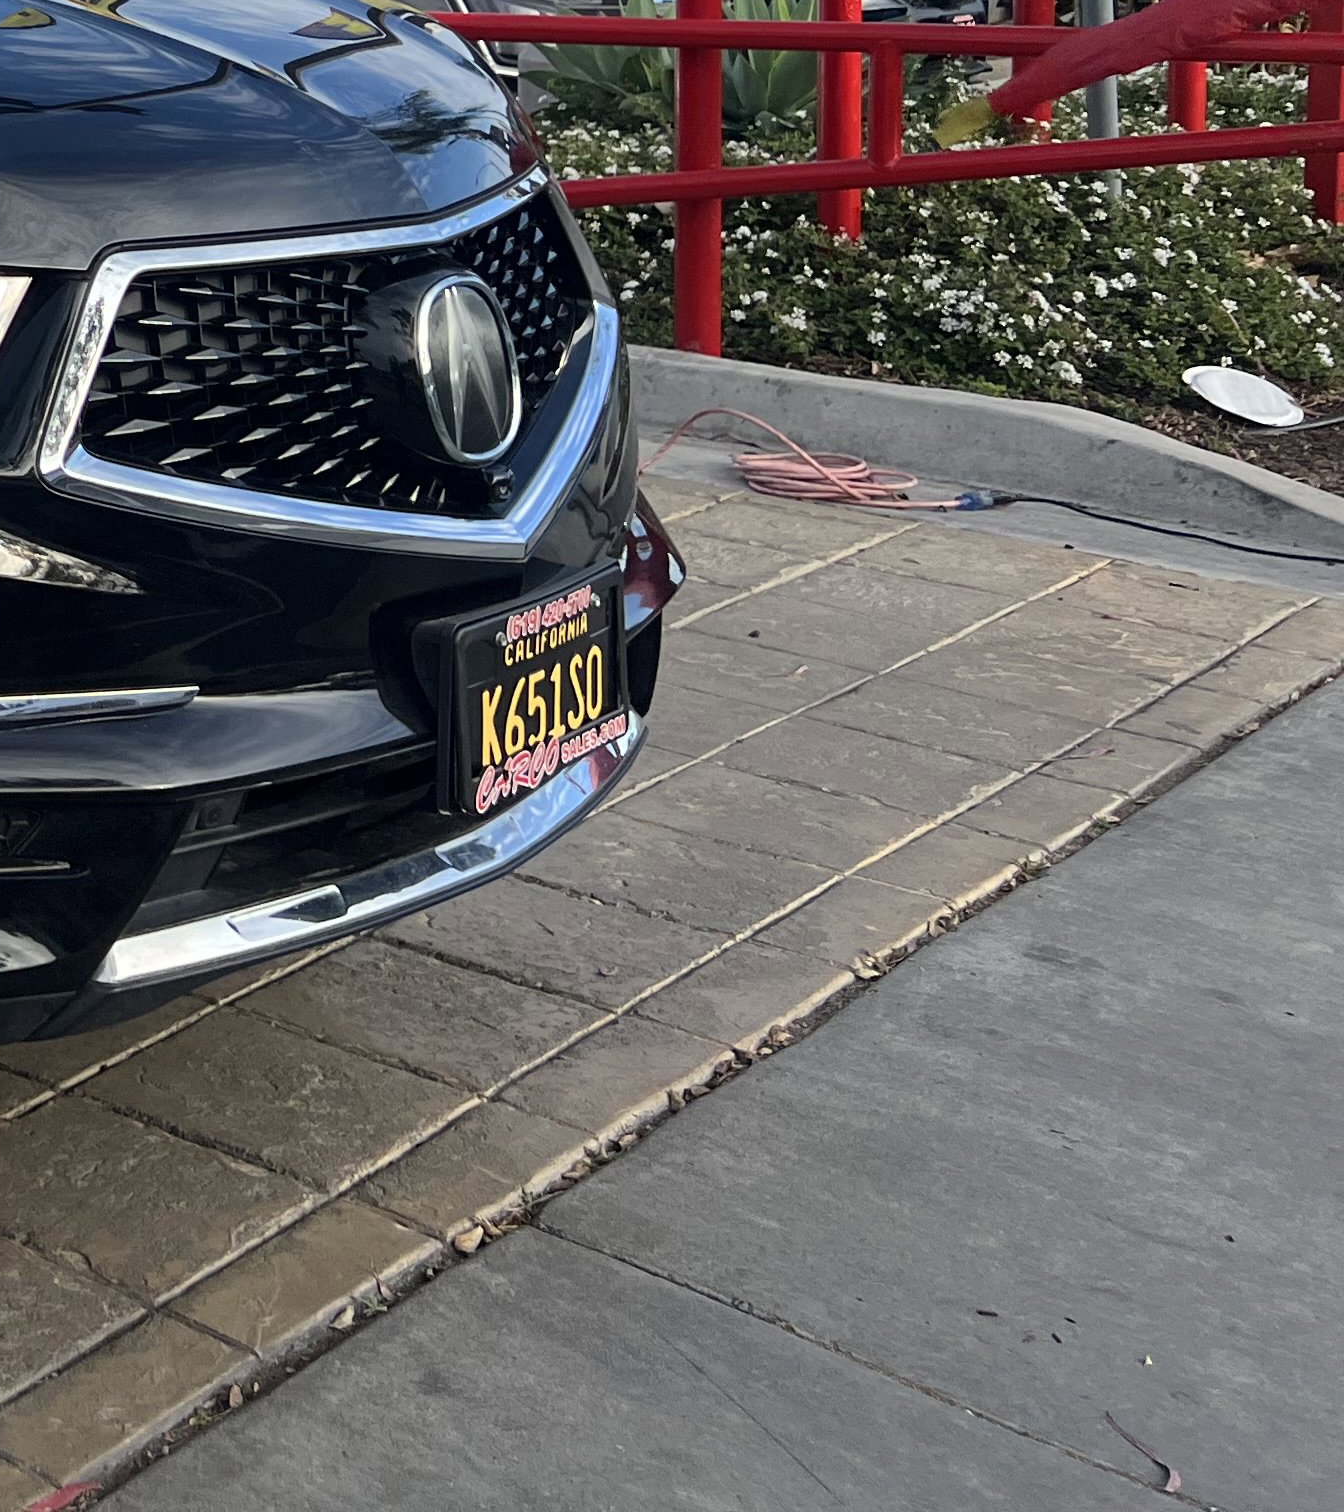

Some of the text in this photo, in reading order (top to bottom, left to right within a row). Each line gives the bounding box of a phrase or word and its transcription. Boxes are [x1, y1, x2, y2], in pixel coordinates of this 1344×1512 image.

[504, 612, 588, 667] CALIFORNIA
[506, 584, 592, 643] (619) 420-5700
[476, 713, 627, 814] CARCO SALES.COM
